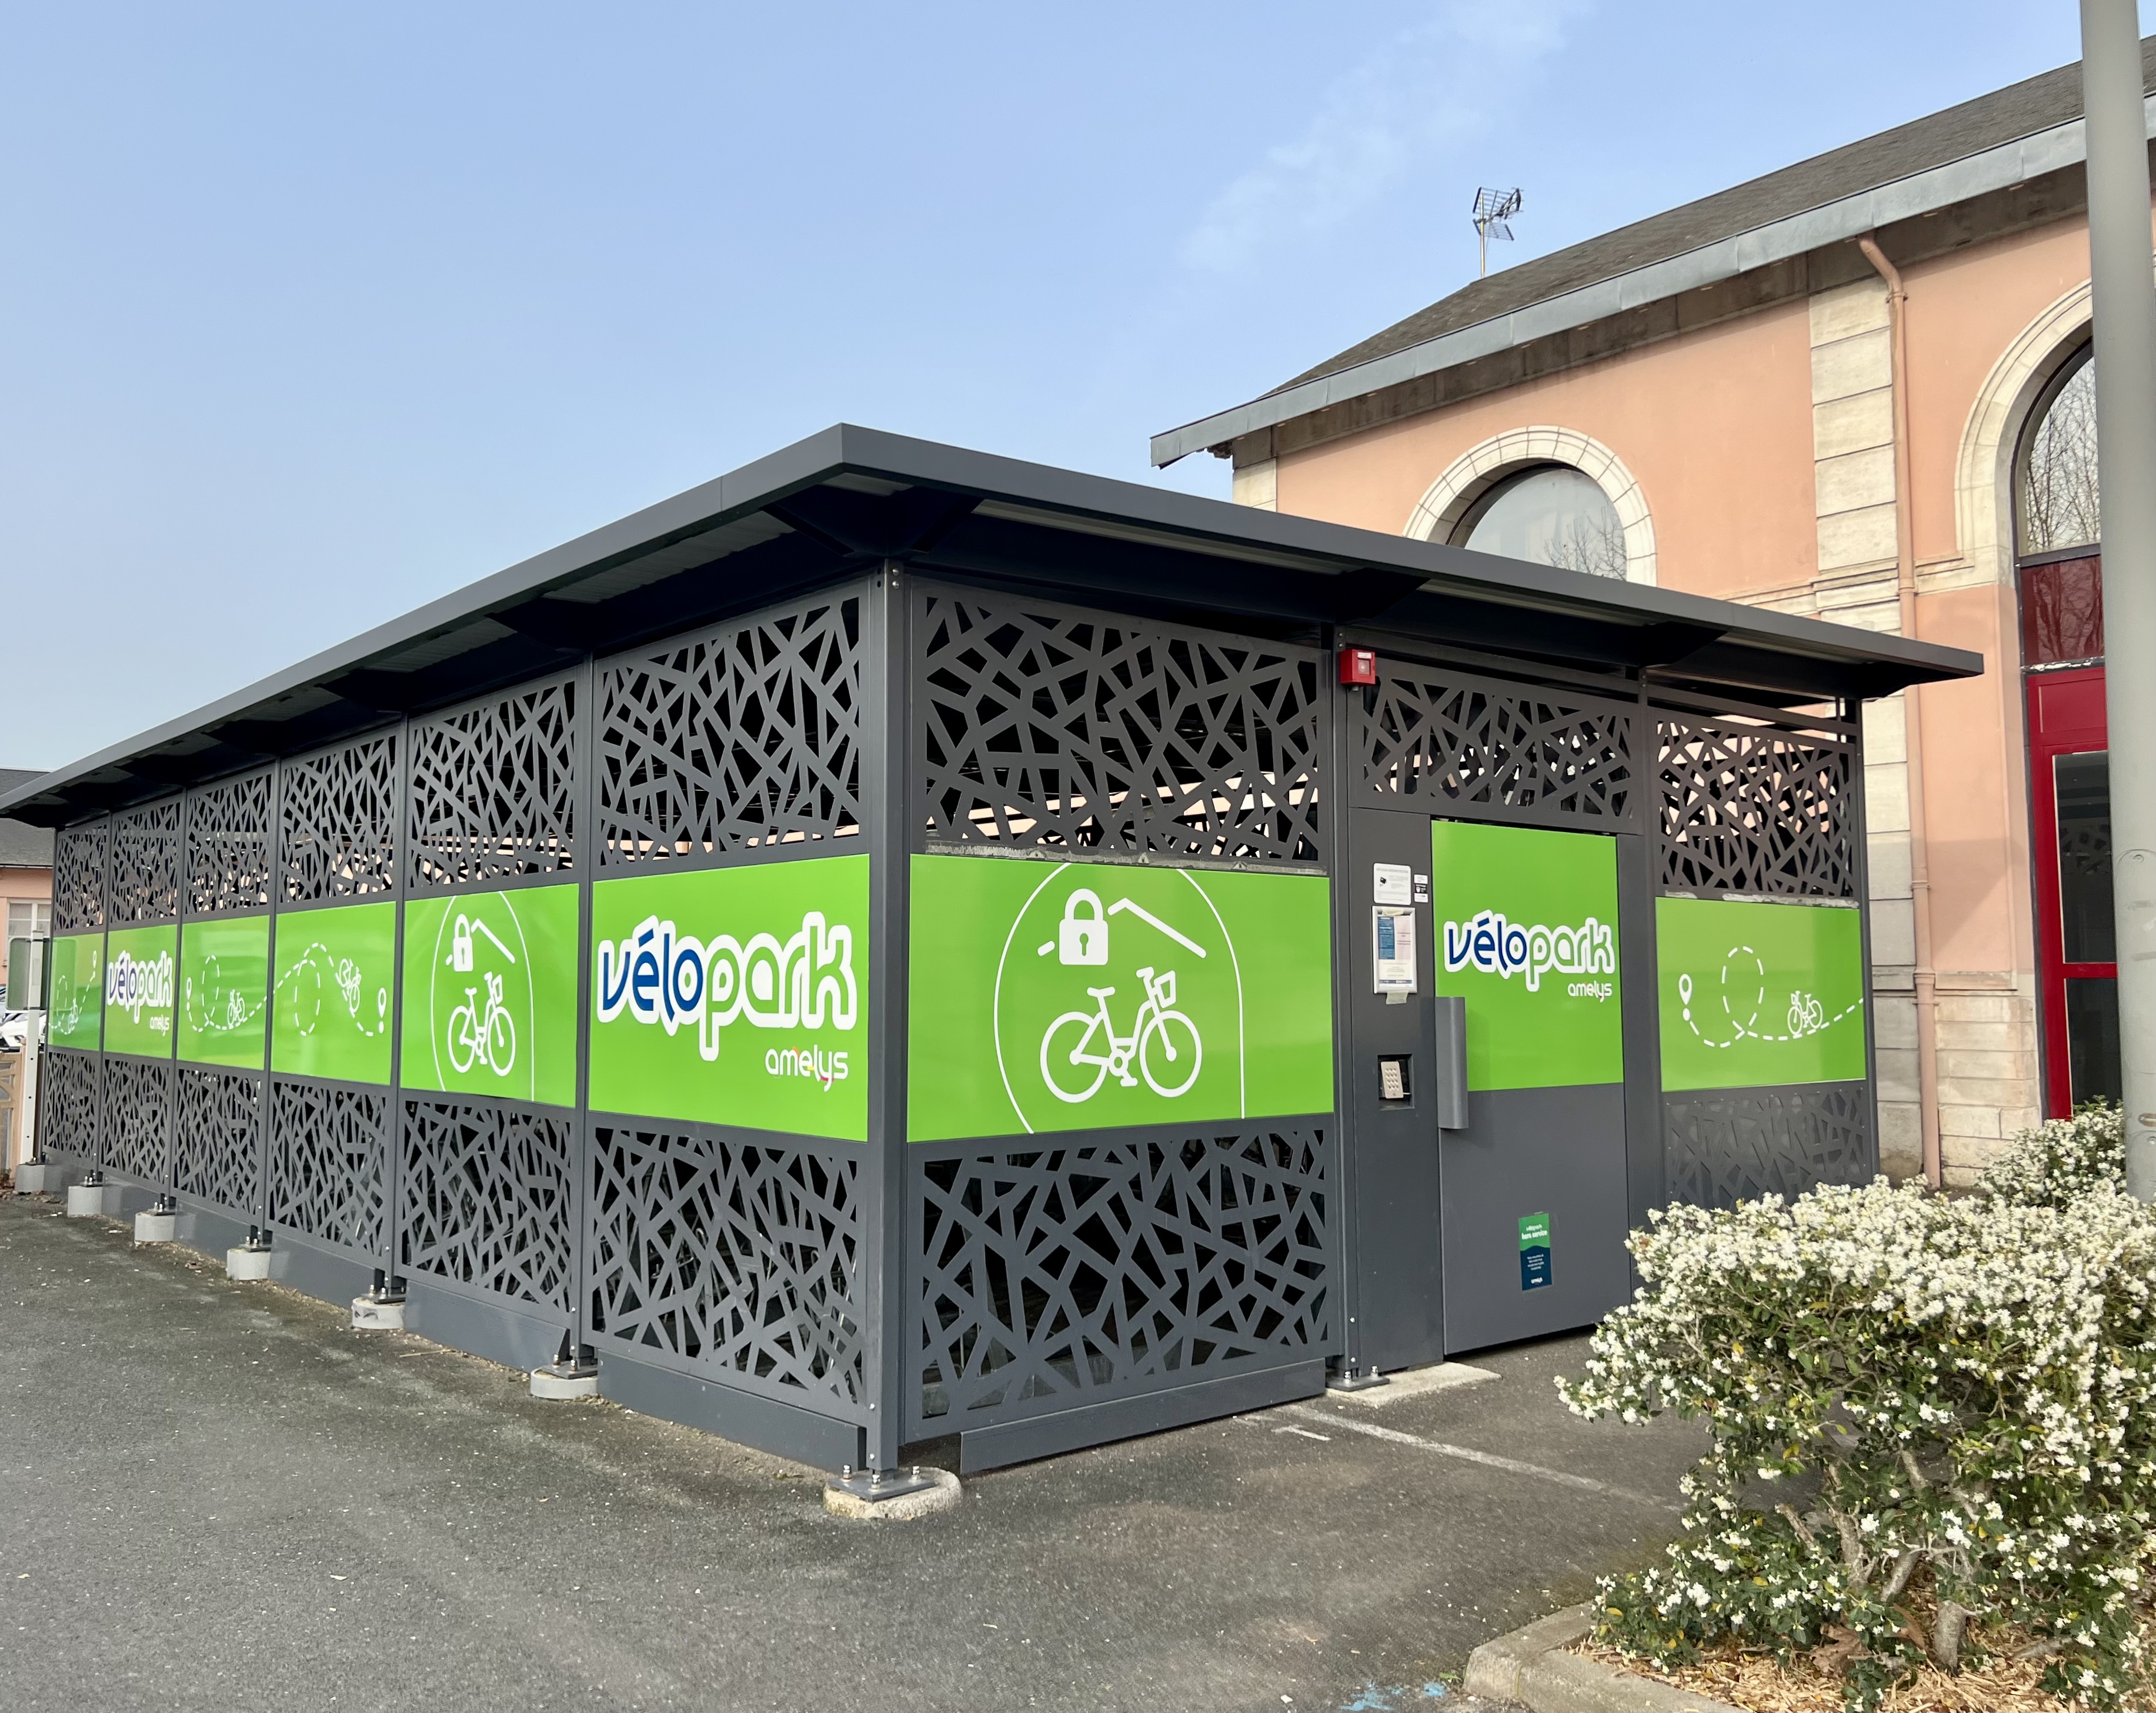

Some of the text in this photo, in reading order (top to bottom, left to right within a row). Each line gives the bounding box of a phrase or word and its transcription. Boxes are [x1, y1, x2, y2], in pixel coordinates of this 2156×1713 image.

[107, 950, 173, 1024] vélopark
[597, 911, 857, 1061] vélopark
[1444, 909, 1616, 992] vélopark
[1567, 980, 1613, 1003] amelys
[766, 1044, 849, 1091] amelys
